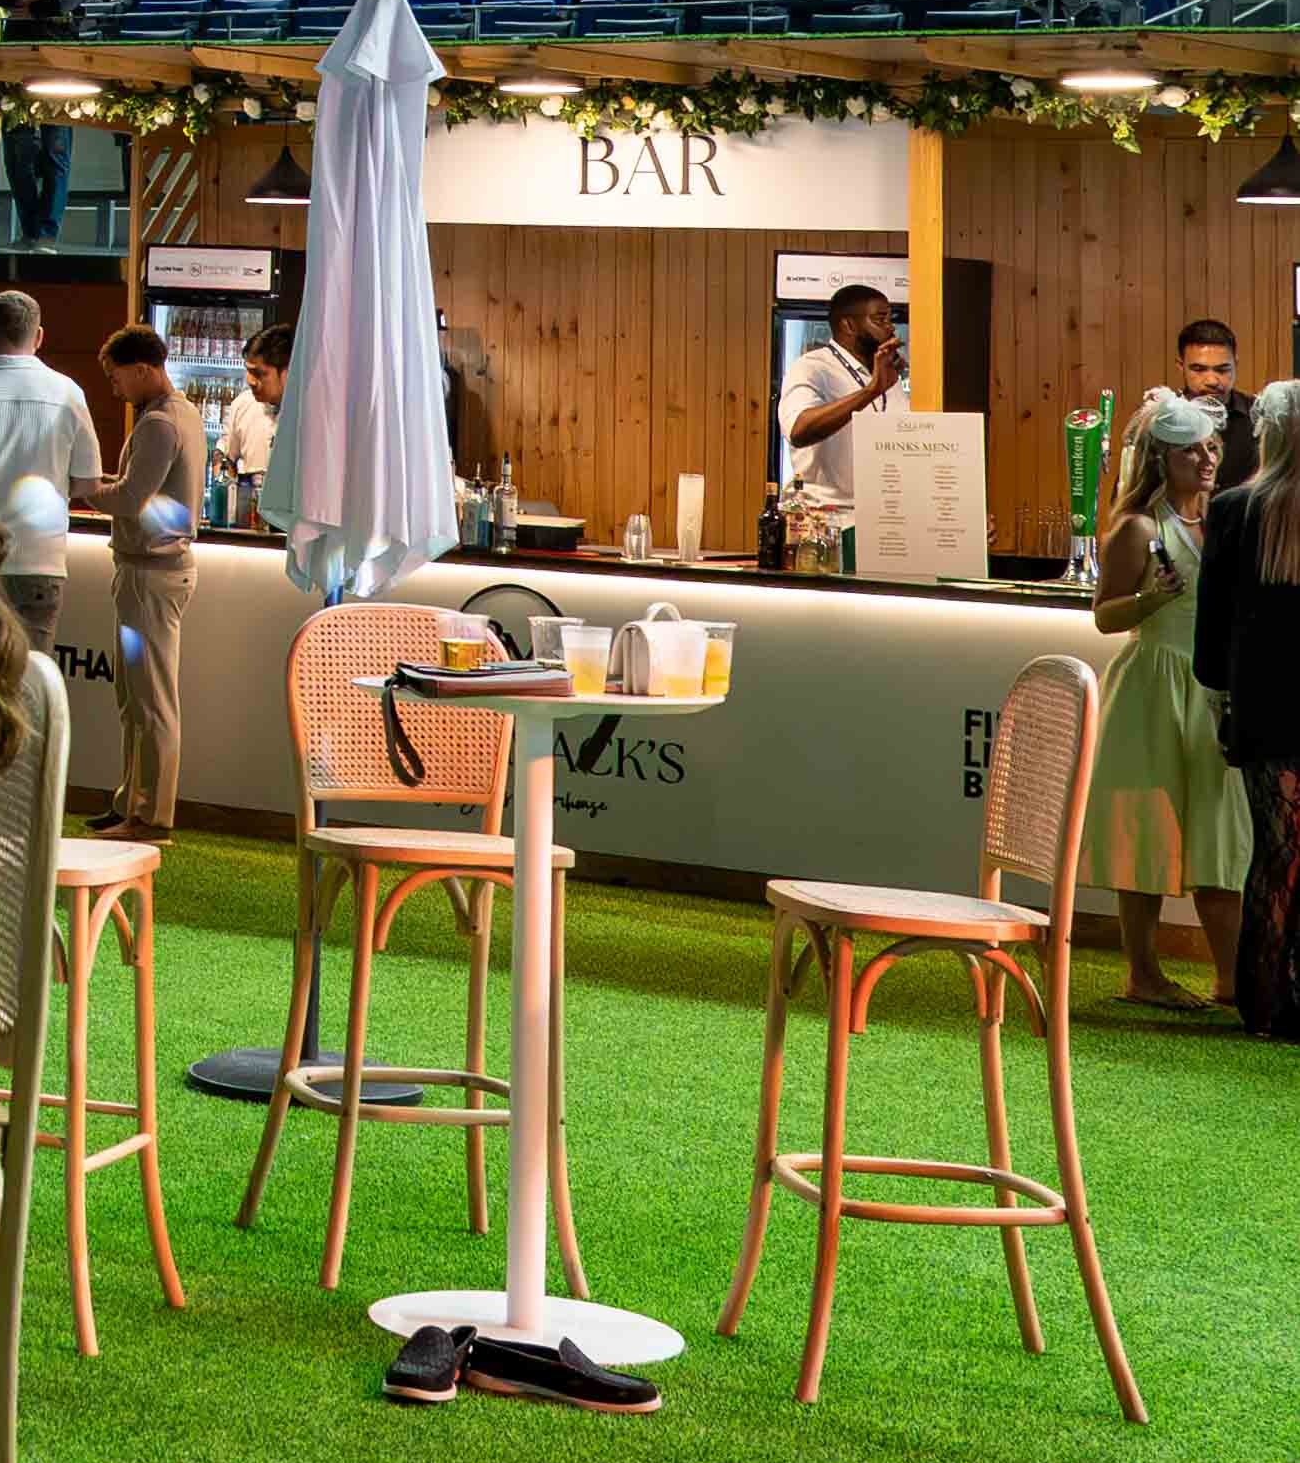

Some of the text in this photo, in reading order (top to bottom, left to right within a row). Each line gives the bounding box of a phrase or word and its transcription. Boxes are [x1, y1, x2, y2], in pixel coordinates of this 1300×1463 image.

[578, 135, 726, 196] BAR
[874, 441, 960, 453] DRINKS MENU
[1071, 435, 1085, 496] Heineken
[54, 644, 114, 683] THA
[964, 709, 1000, 738] FI
